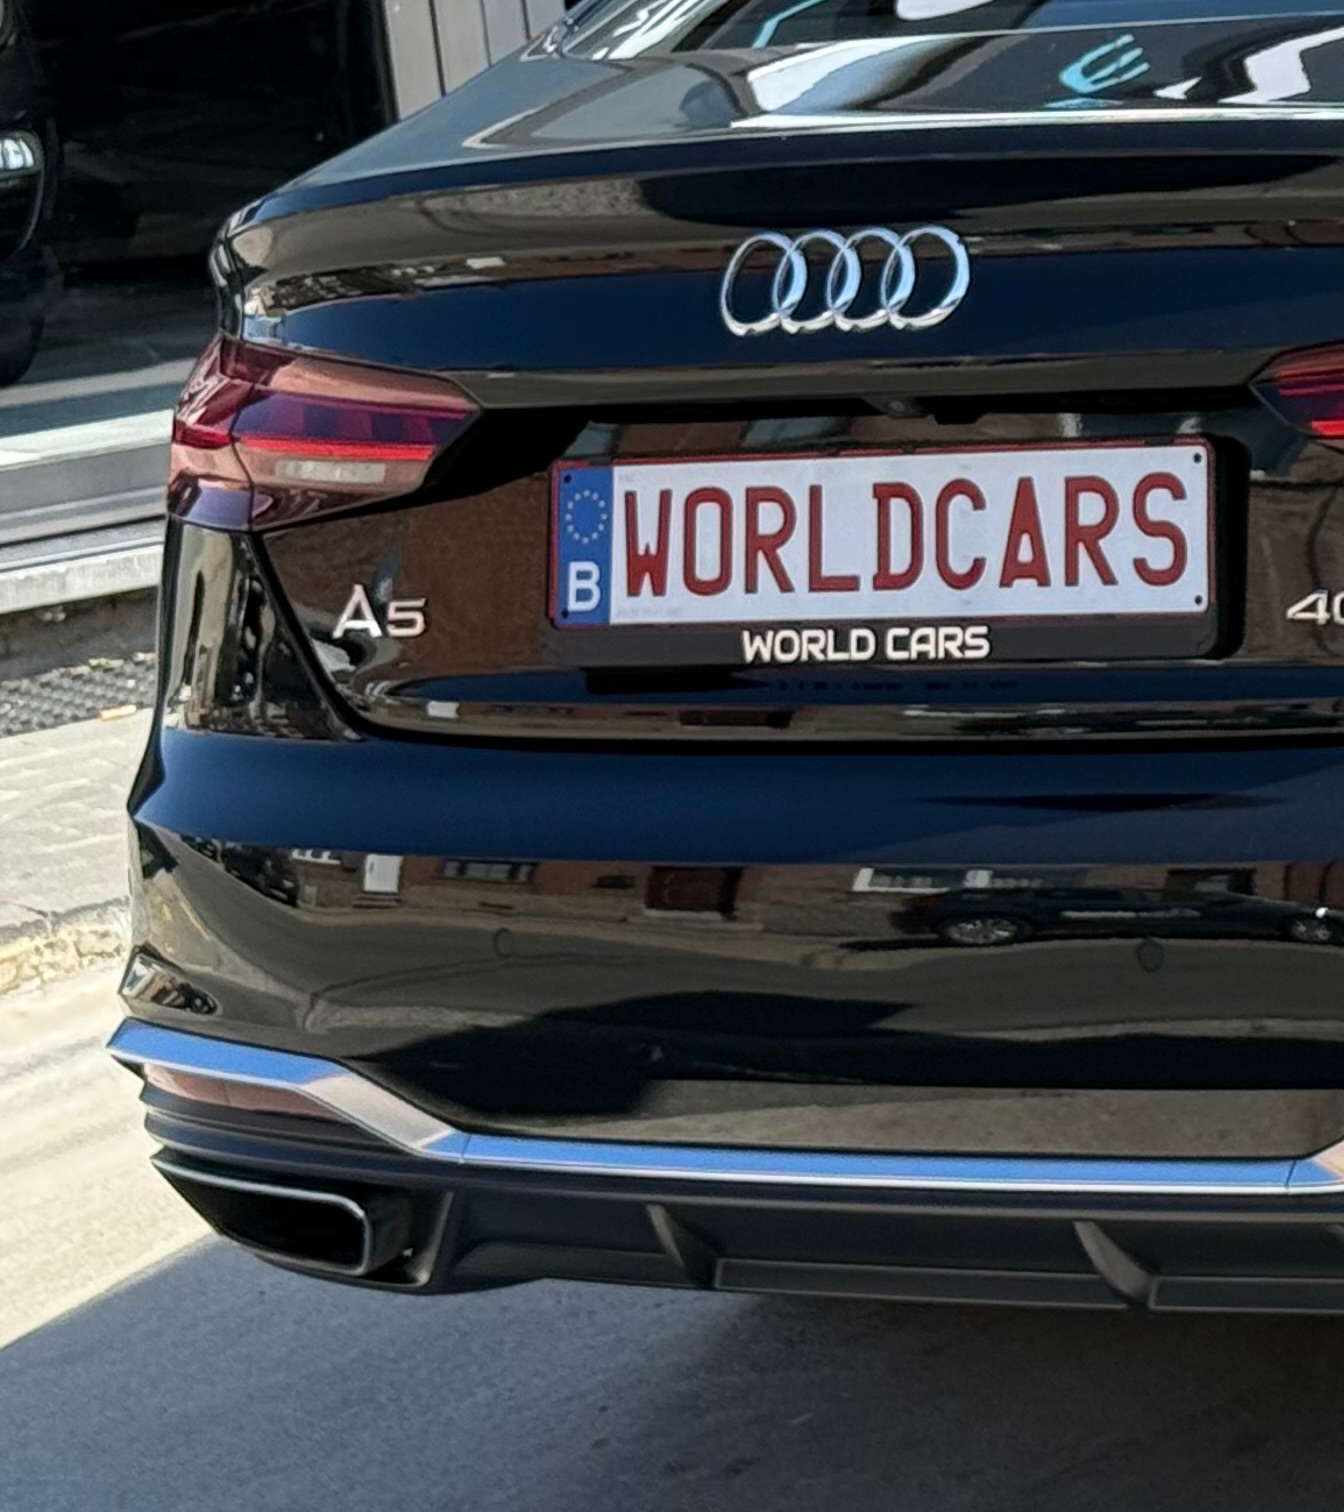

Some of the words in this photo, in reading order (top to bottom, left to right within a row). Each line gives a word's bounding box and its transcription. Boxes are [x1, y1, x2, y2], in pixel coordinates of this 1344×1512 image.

[623, 471, 1189, 598] WORLDCARS
[331, 583, 428, 639] A5
[566, 560, 602, 613] B
[741, 626, 876, 664] WORLD
[884, 624, 991, 660] CARS
